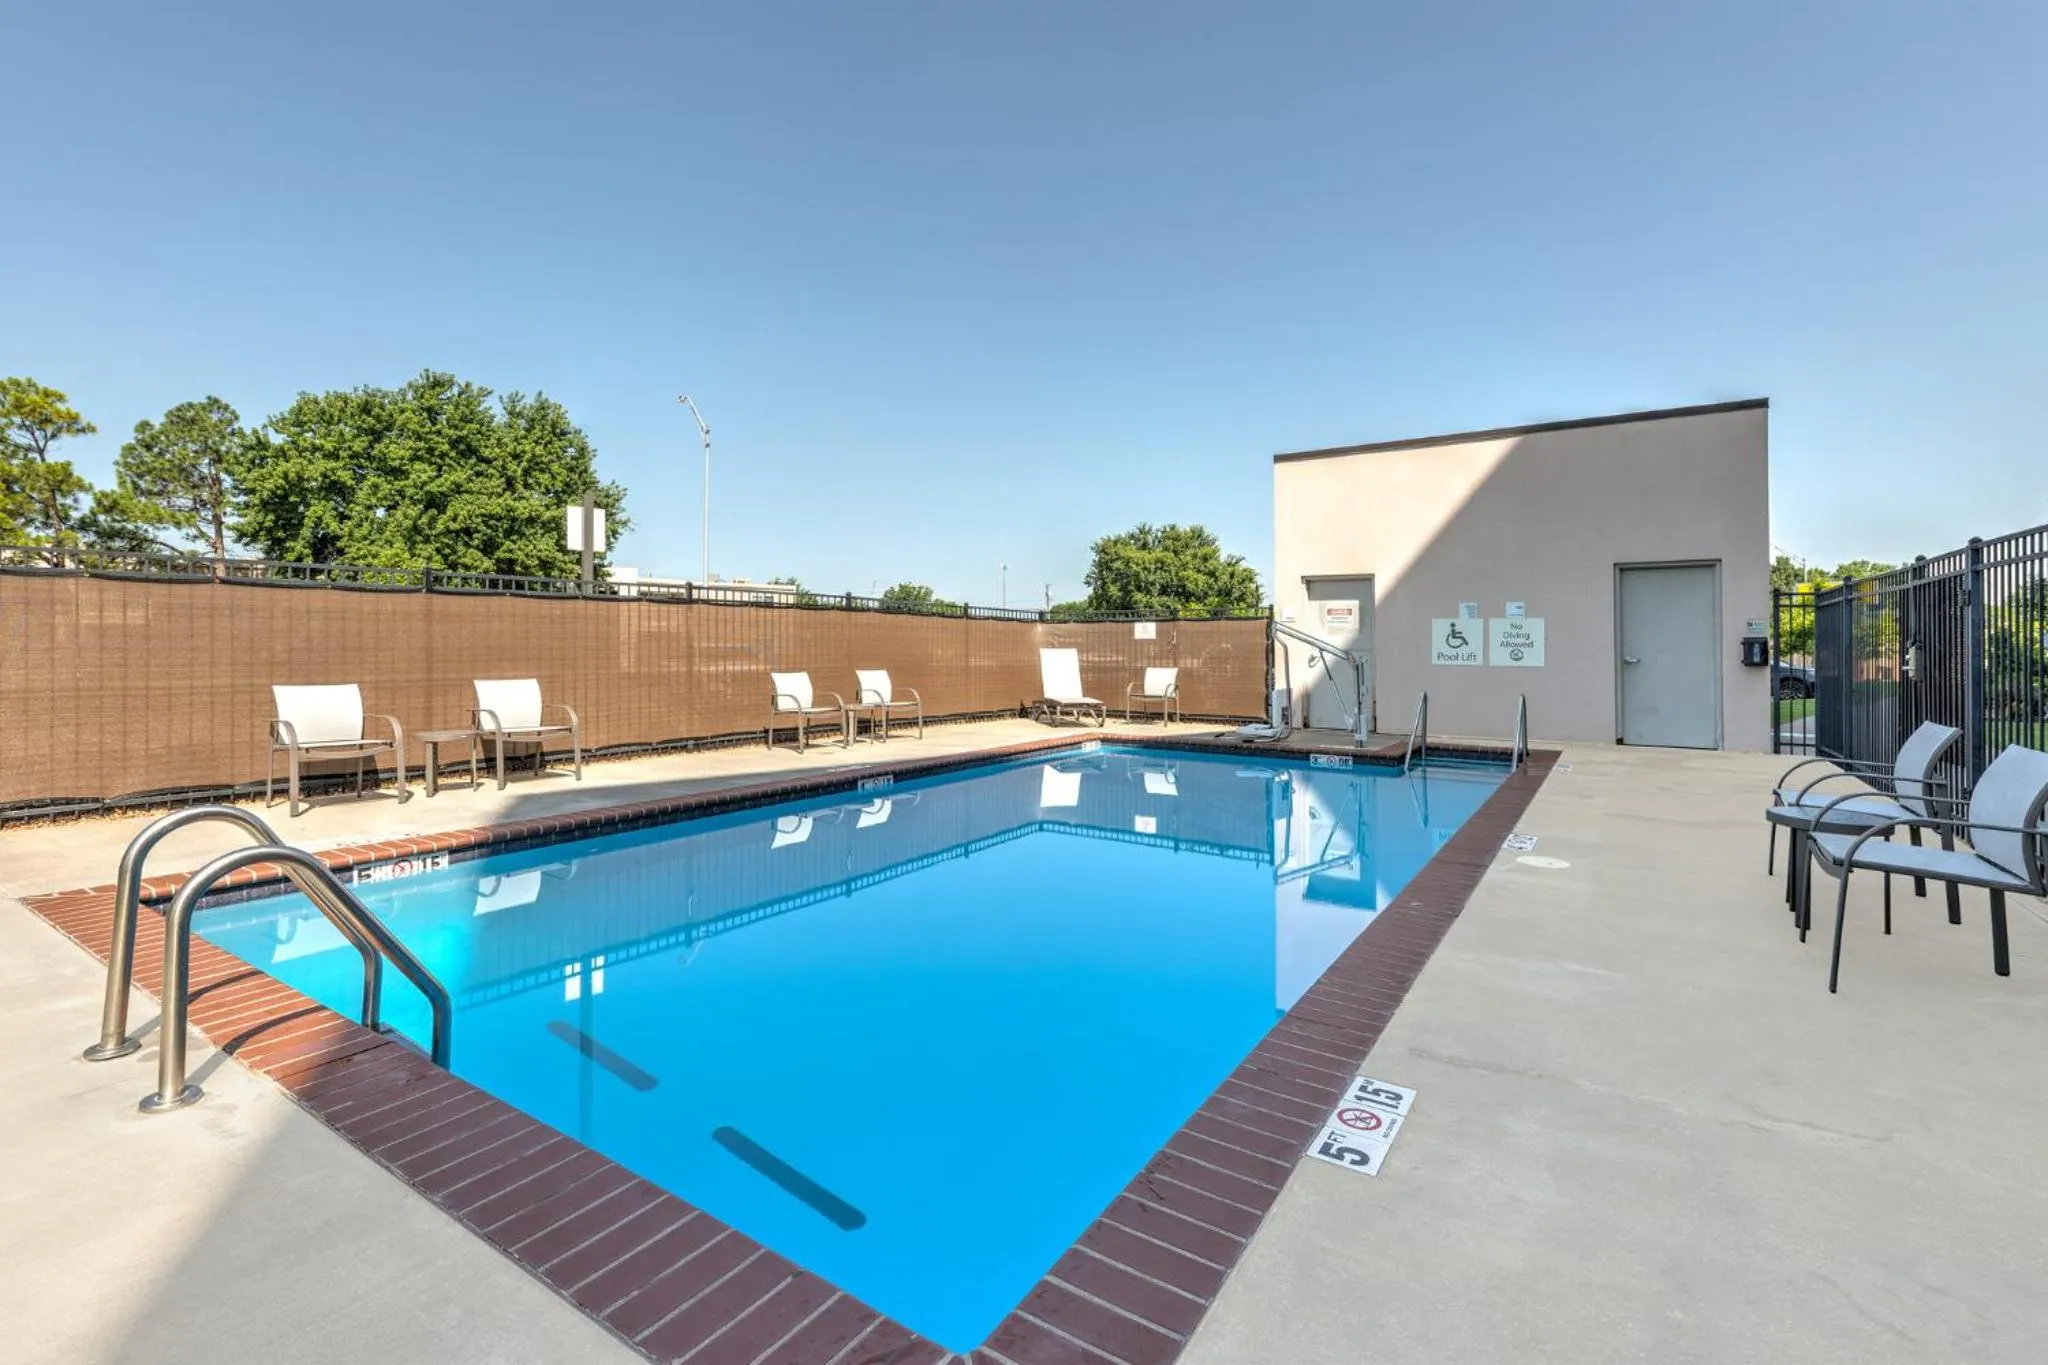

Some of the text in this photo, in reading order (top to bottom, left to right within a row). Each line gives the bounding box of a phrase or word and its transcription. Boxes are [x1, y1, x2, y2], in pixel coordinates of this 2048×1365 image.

[1502, 631, 1530, 641] Diving
[1499, 640, 1534, 648] Allowed
[1437, 652, 1477, 661] Pool Lift
[1318, 1141, 1370, 1167] 5
